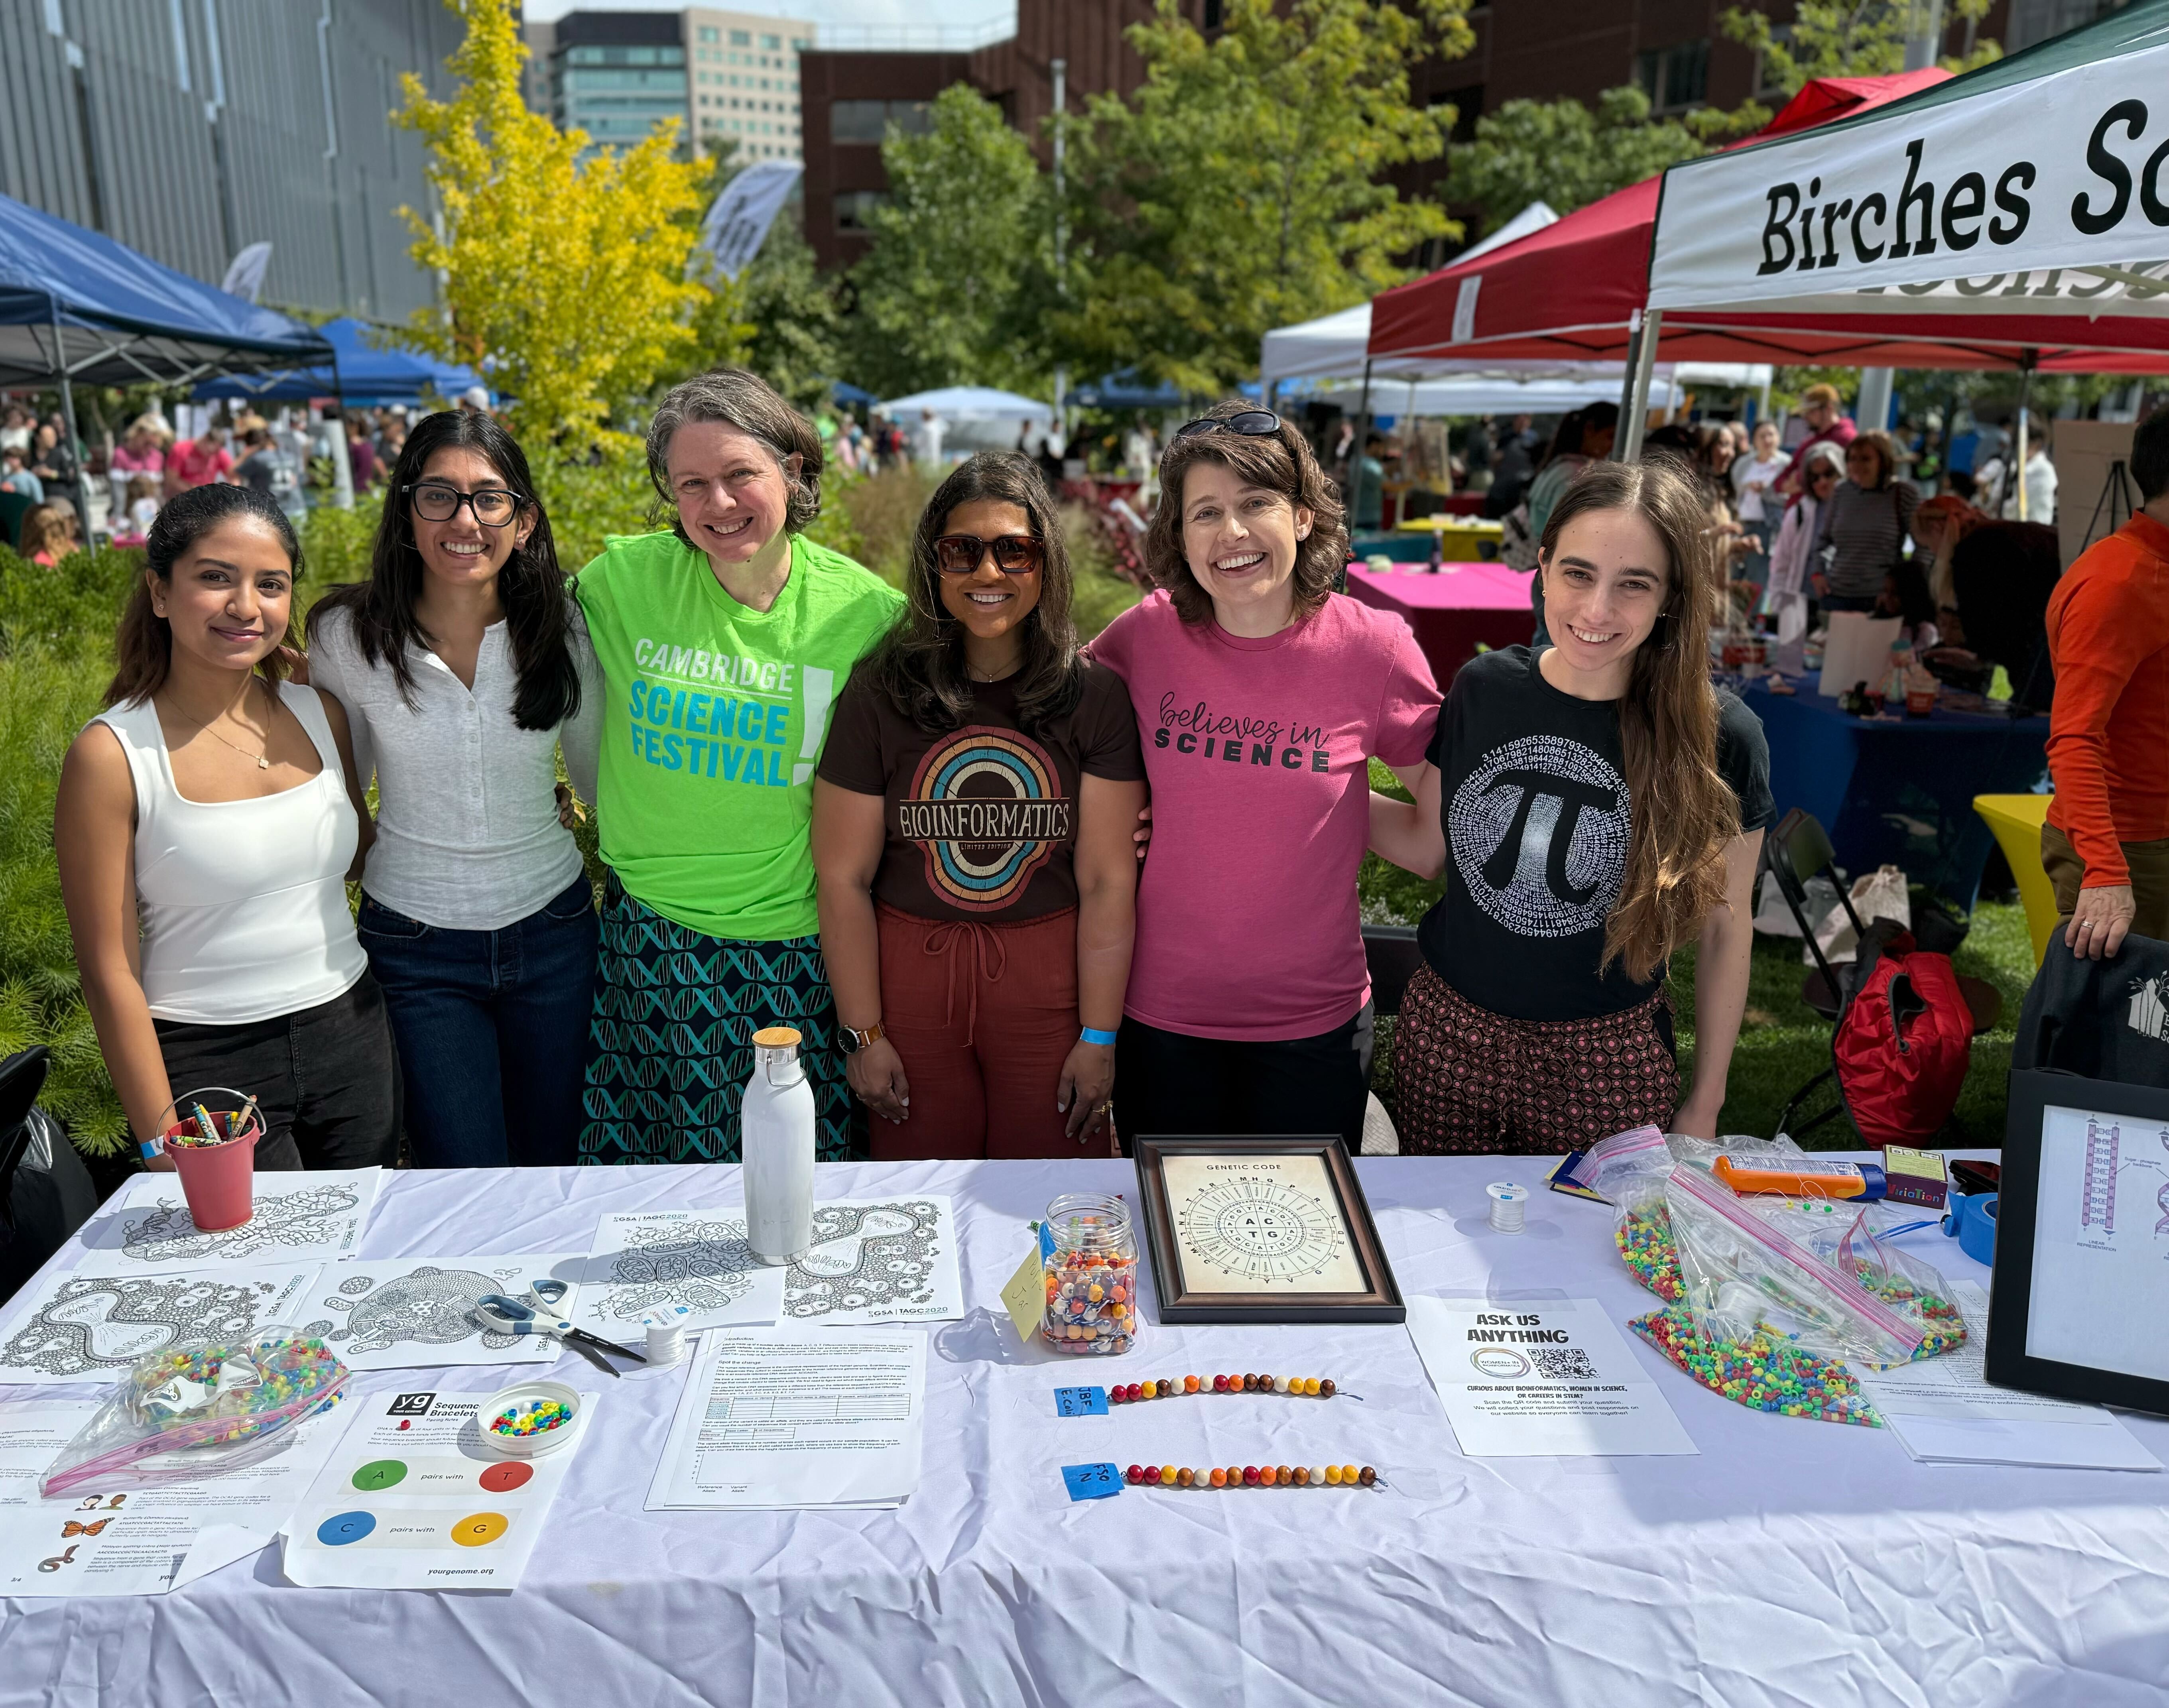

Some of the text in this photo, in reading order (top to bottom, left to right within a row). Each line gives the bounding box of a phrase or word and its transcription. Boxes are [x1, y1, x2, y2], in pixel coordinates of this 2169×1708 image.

[1757, 138, 2036, 275] Birches
[635, 639, 794, 692] CAMBRIDGE
[629, 679, 789, 745] SCIENCE
[1160, 692, 1330, 749] believes in
[1155, 728, 1330, 772] SCIENCE
[900, 803, 1069, 837] BIOINFORMATICS
[1888, 1183, 1939, 1202] VariaTion
[2077, 1242, 2116, 1251] REPRESENTATION
[269, 1275, 302, 1314] GSA TAGC2020
[1012, 1286, 1028, 1311] Jar
[1476, 1314, 1541, 1326] ASK US
[538, 1337, 549, 1348] GSA
[1467, 1329, 1569, 1344] ANYTHING
[396, 1395, 430, 1409] yg
[1078, 1387, 1092, 1407] JBF
[373, 1471, 385, 1480] A
[341, 1524, 354, 1532] C
[473, 1525, 486, 1533] G
